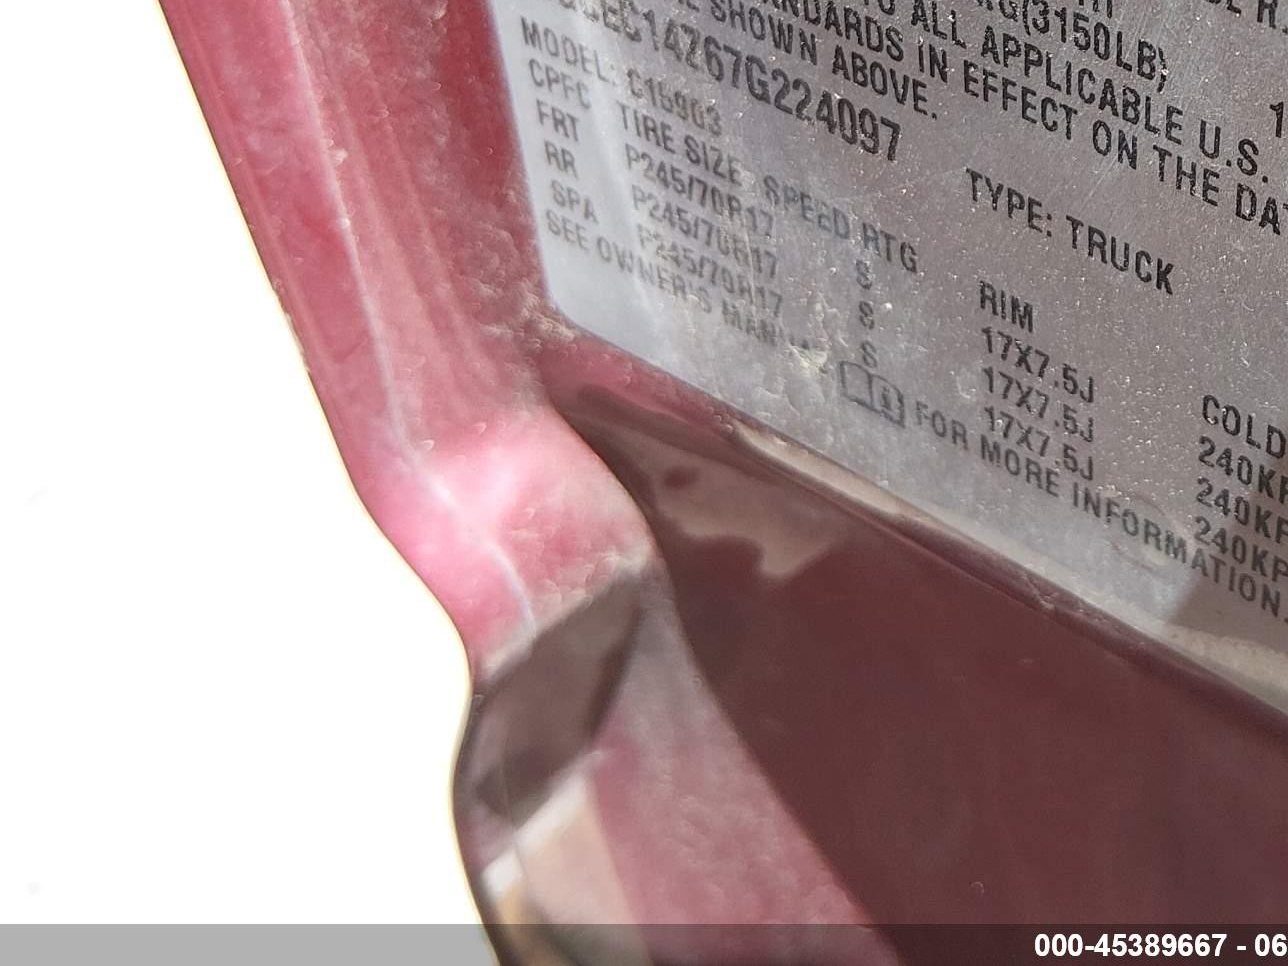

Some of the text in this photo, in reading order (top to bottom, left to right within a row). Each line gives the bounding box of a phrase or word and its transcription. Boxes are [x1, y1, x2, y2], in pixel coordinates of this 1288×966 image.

[536, 99, 580, 142] FRT
[832, 45, 937, 119] ABOVE.
[917, 38, 948, 82] IN
[964, 59, 1077, 140] EFFECT
[1093, 121, 1137, 170] ON
[1153, 145, 1219, 207] THE
[982, 26, 1184, 144] APPLICABLE
[1200, 121, 1269, 184] U.S.
[544, 140, 579, 178] RR
[551, 180, 599, 223] SPA
[617, 100, 685, 154] TIRE
[684, 134, 742, 187] SIZE
[861, 222, 917, 273] RTG
[979, 280, 1033, 333] RIM
[1202, 394, 1286, 460] COLD
[966, 167, 1174, 295] TYPE: TRUCK
[546, 209, 588, 250] SEE
[915, 402, 968, 451] FOR
[980, 437, 1060, 498] MORE
